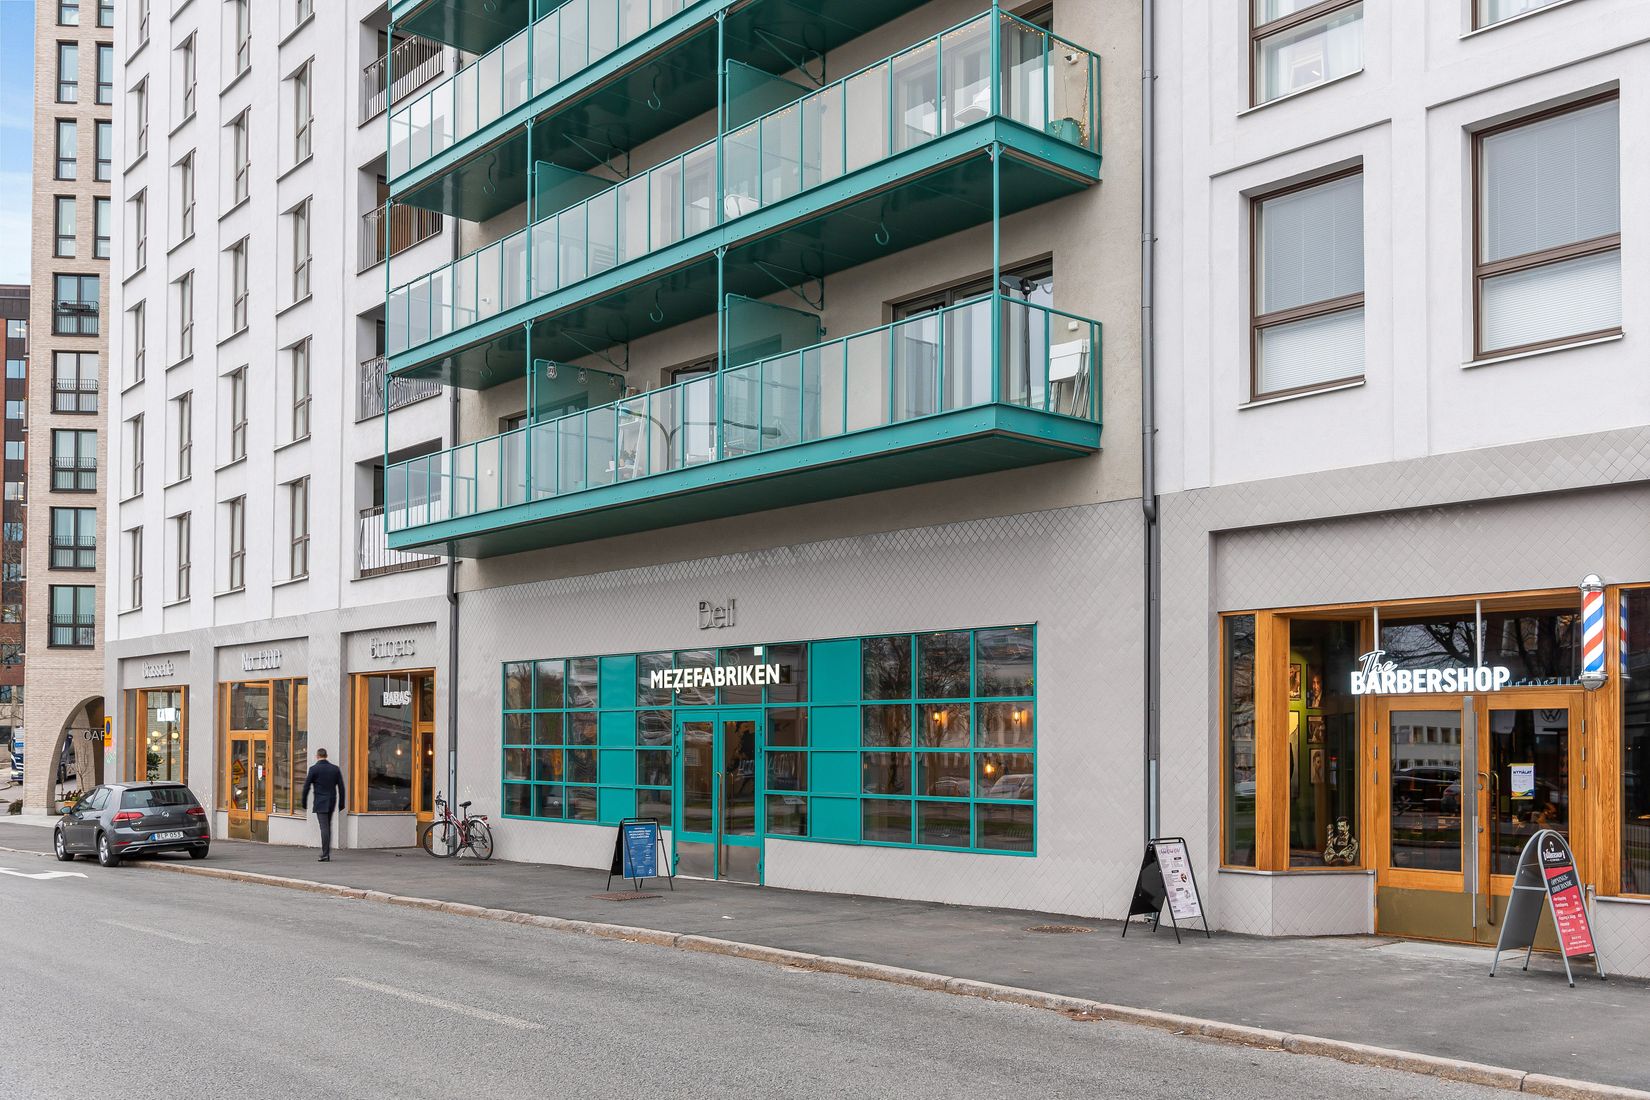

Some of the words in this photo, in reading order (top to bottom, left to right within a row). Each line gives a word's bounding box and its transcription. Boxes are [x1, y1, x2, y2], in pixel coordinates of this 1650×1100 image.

[697, 598, 735, 629] Deli
[370, 638, 415, 663] Burgers
[1359, 650, 1398, 676] The
[143, 659, 175, 679] Brasserie
[1350, 666, 1511, 695] BARBERSHOP
[383, 691, 411, 706] BABAS
